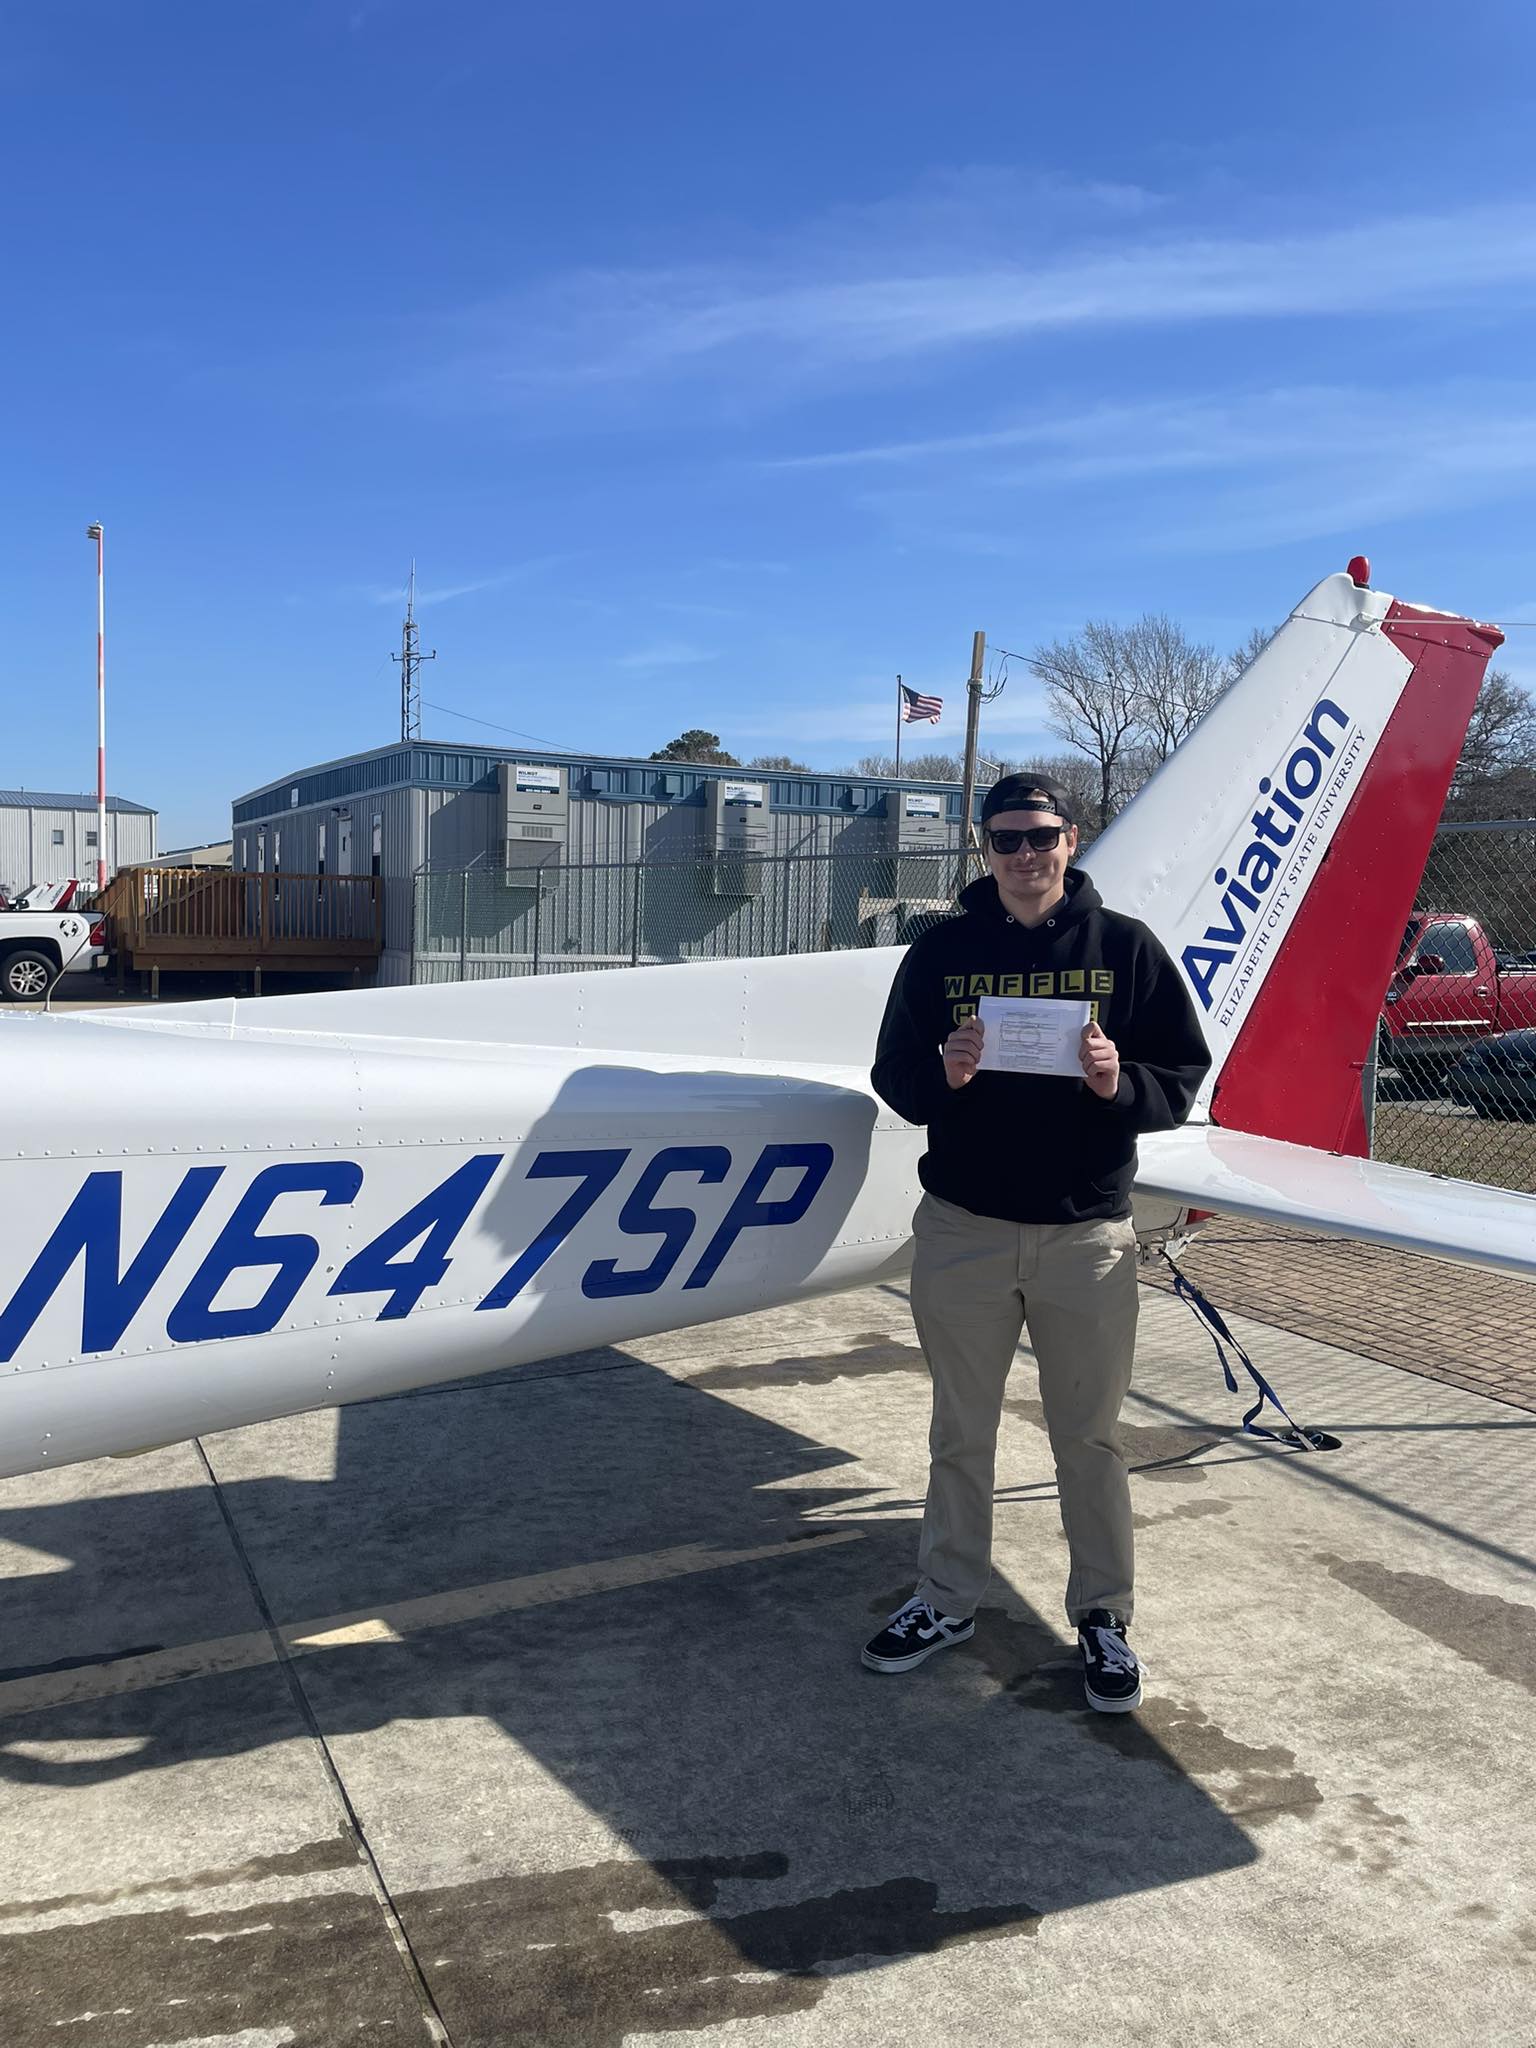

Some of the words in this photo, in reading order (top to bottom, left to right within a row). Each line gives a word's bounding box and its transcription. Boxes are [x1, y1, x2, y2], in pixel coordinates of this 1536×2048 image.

[944, 971, 1112, 998] WAFFLE
[1181, 698, 1350, 1013] Aviation
[1219, 933, 1271, 1027] ELIZABETH
[1267, 886, 1291, 929] CITY
[1287, 833, 1318, 885] STATE
[1315, 729, 1367, 830] UNIVERSITY
[0, 1142, 835, 1363] N647SP
